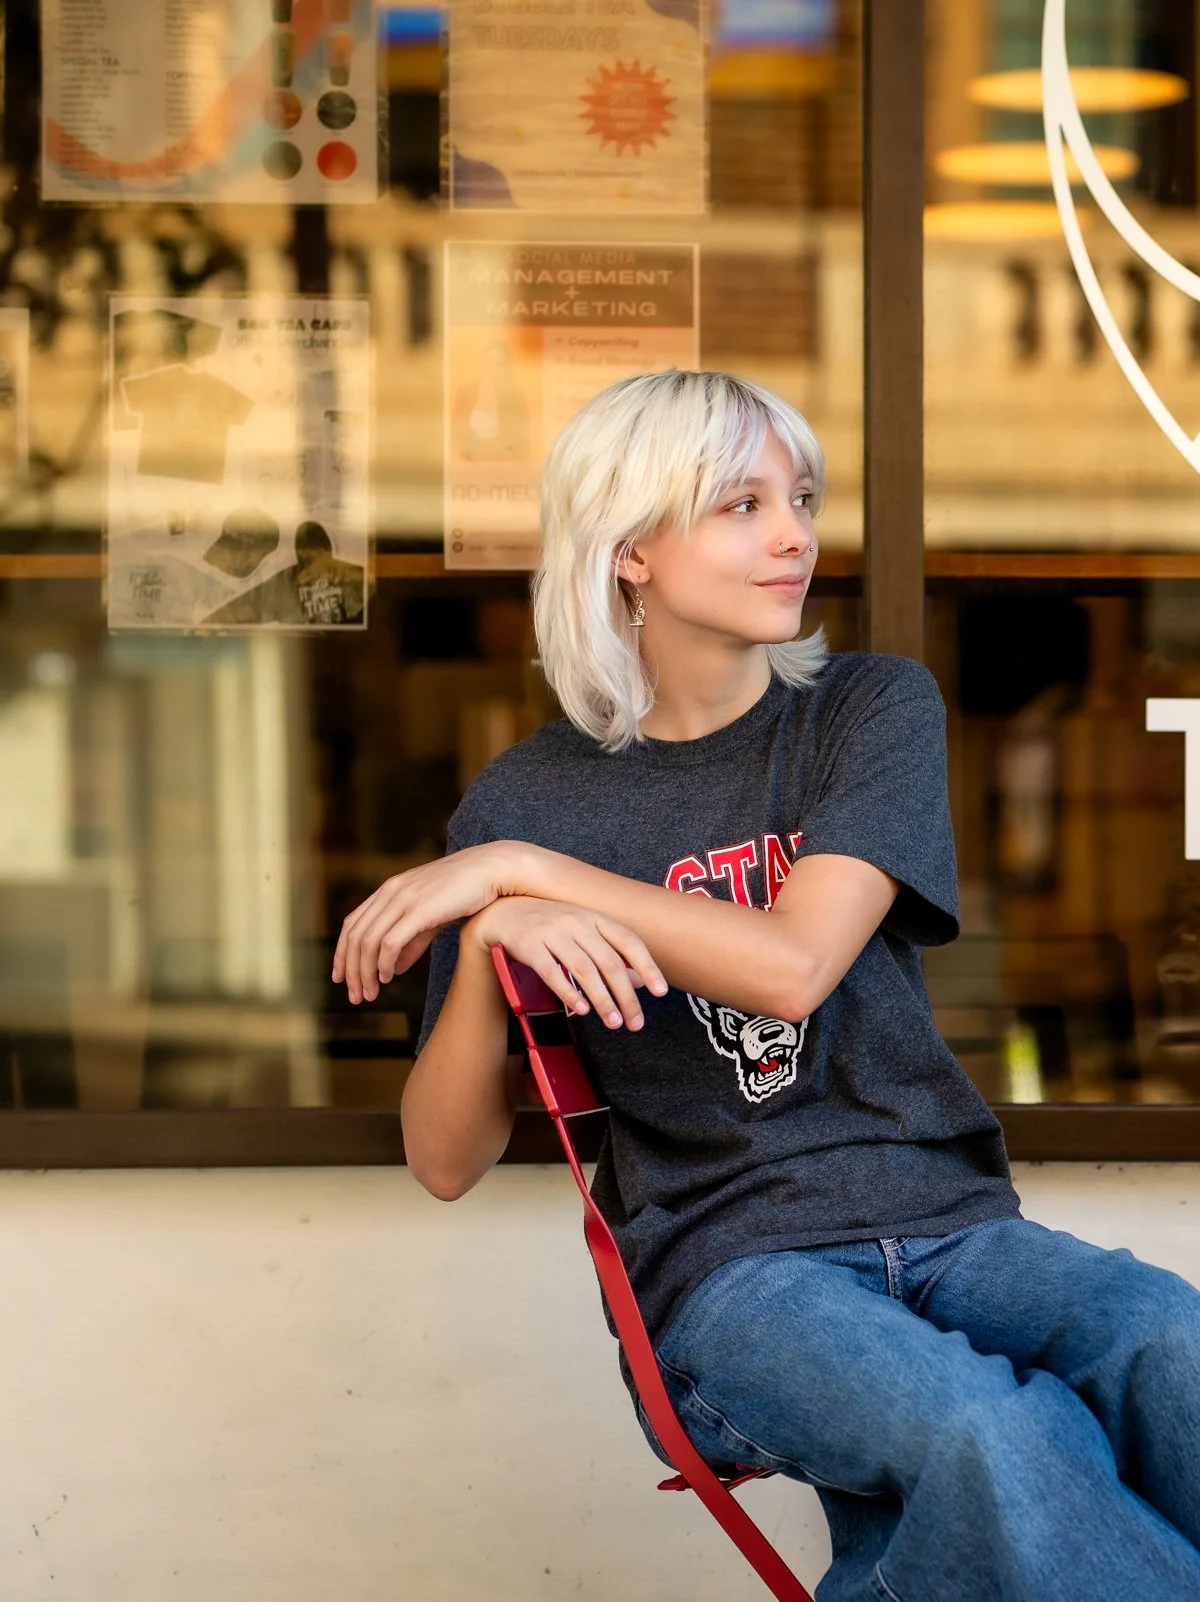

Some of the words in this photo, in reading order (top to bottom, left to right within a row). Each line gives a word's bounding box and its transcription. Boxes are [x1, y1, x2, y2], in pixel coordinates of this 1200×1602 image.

[472, 25, 619, 51] TUESDAYS
[509, 251, 571, 264] SOCIAL
[580, 251, 636, 264] MEDIA
[469, 269, 674, 285] MANAGEMENT
[487, 301, 657, 317] MARKETING
[663, 831, 803, 912] STA
